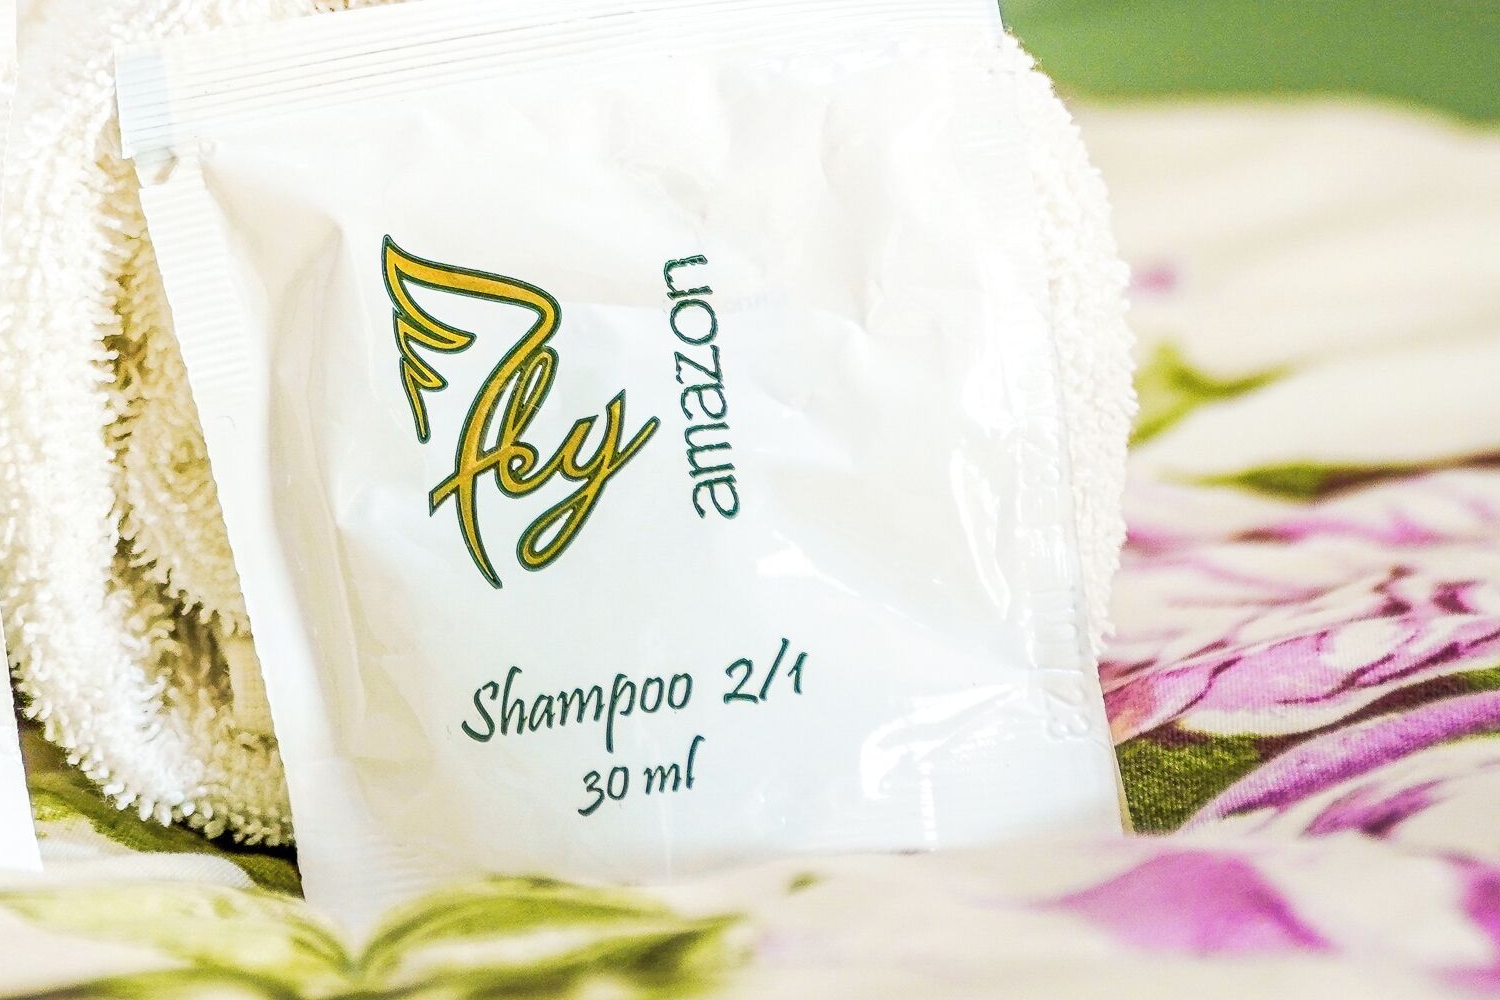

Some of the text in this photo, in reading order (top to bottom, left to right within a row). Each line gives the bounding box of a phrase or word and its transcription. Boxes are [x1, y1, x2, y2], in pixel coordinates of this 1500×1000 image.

[664, 254, 741, 520] amazon
[461, 637, 808, 753] Shampoo 2/1
[577, 734, 706, 817] 30 ml
